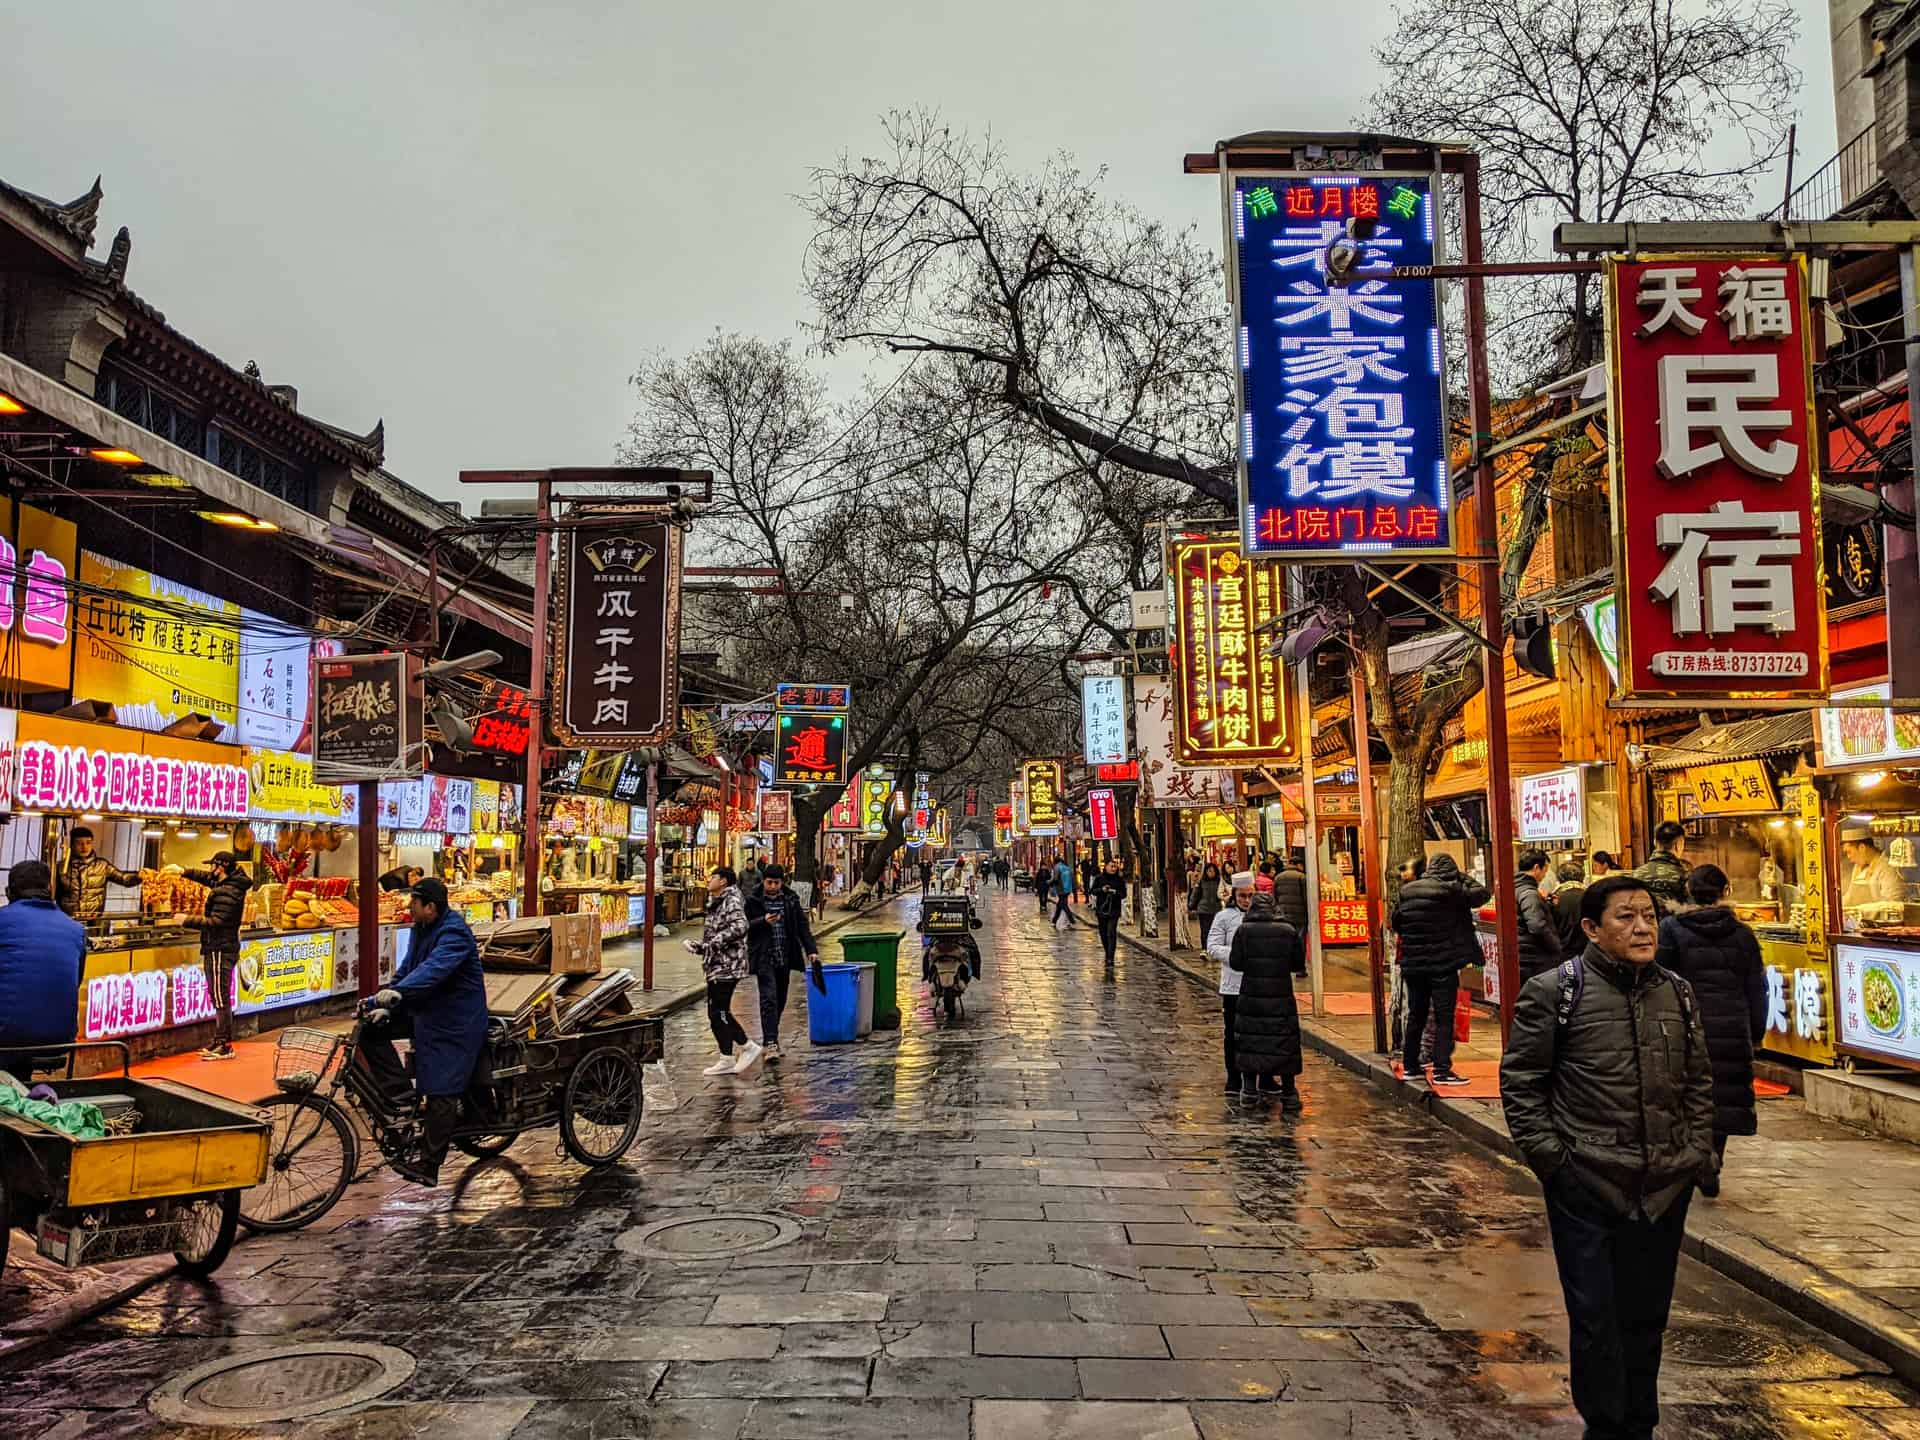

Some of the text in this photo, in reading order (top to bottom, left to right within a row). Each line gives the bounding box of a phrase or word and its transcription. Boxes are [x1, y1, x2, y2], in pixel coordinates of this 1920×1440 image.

[1287, 186, 1379, 216] 近月楼
[1634, 266, 1793, 341] 天福
[1272, 221, 1415, 498] 老米家泡馍
[1260, 505, 1439, 541] 北院门总店
[1649, 354, 1800, 637] 民宿
[592, 590, 638, 726] 风干牛肉
[1217, 575, 1250, 740] 宫廷酥牛肉饼
[21, 747, 109, 804] 章鱼小丸子
[1700, 775, 1765, 803] 肉夹馍
